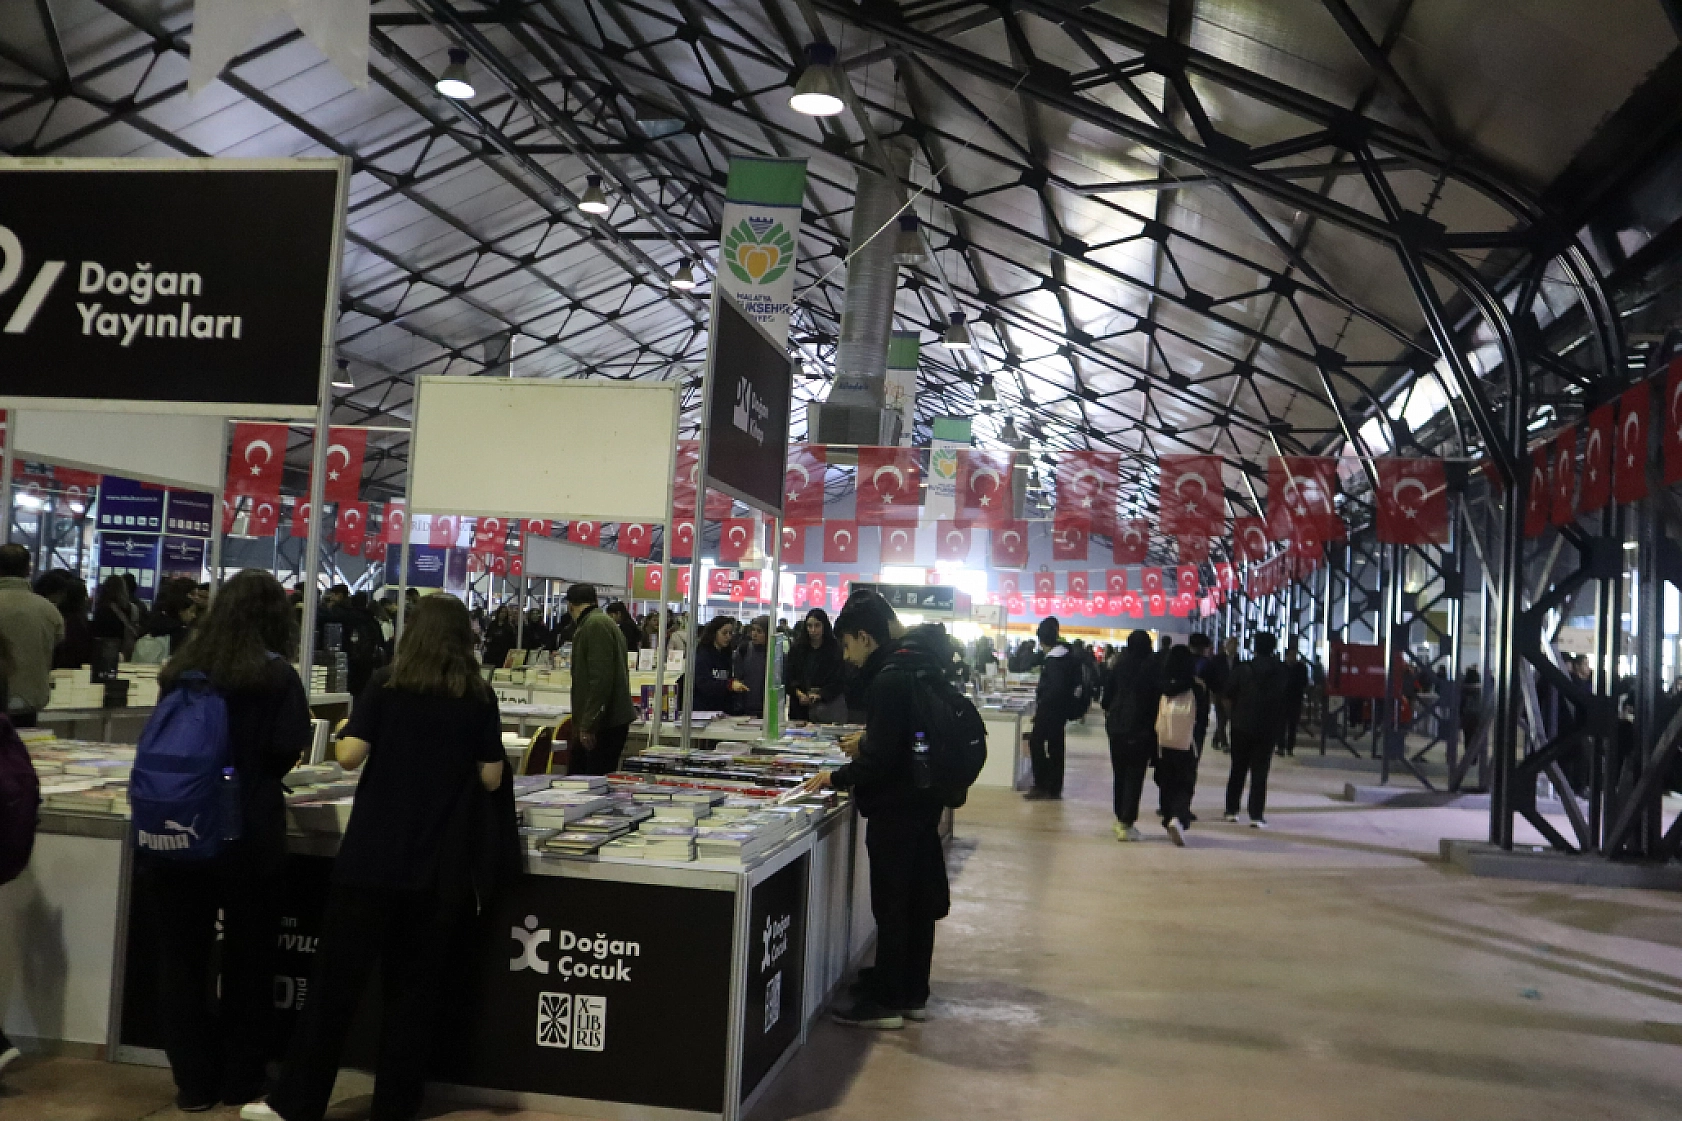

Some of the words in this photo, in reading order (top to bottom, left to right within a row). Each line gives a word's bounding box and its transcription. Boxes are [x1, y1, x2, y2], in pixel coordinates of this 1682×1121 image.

[79, 260, 203, 305] Doğan
[76, 302, 243, 348] Yayınları
[138, 829, 191, 850] PUMA
[559, 929, 641, 960] Doğan
[558, 955, 632, 982] Çocuk
